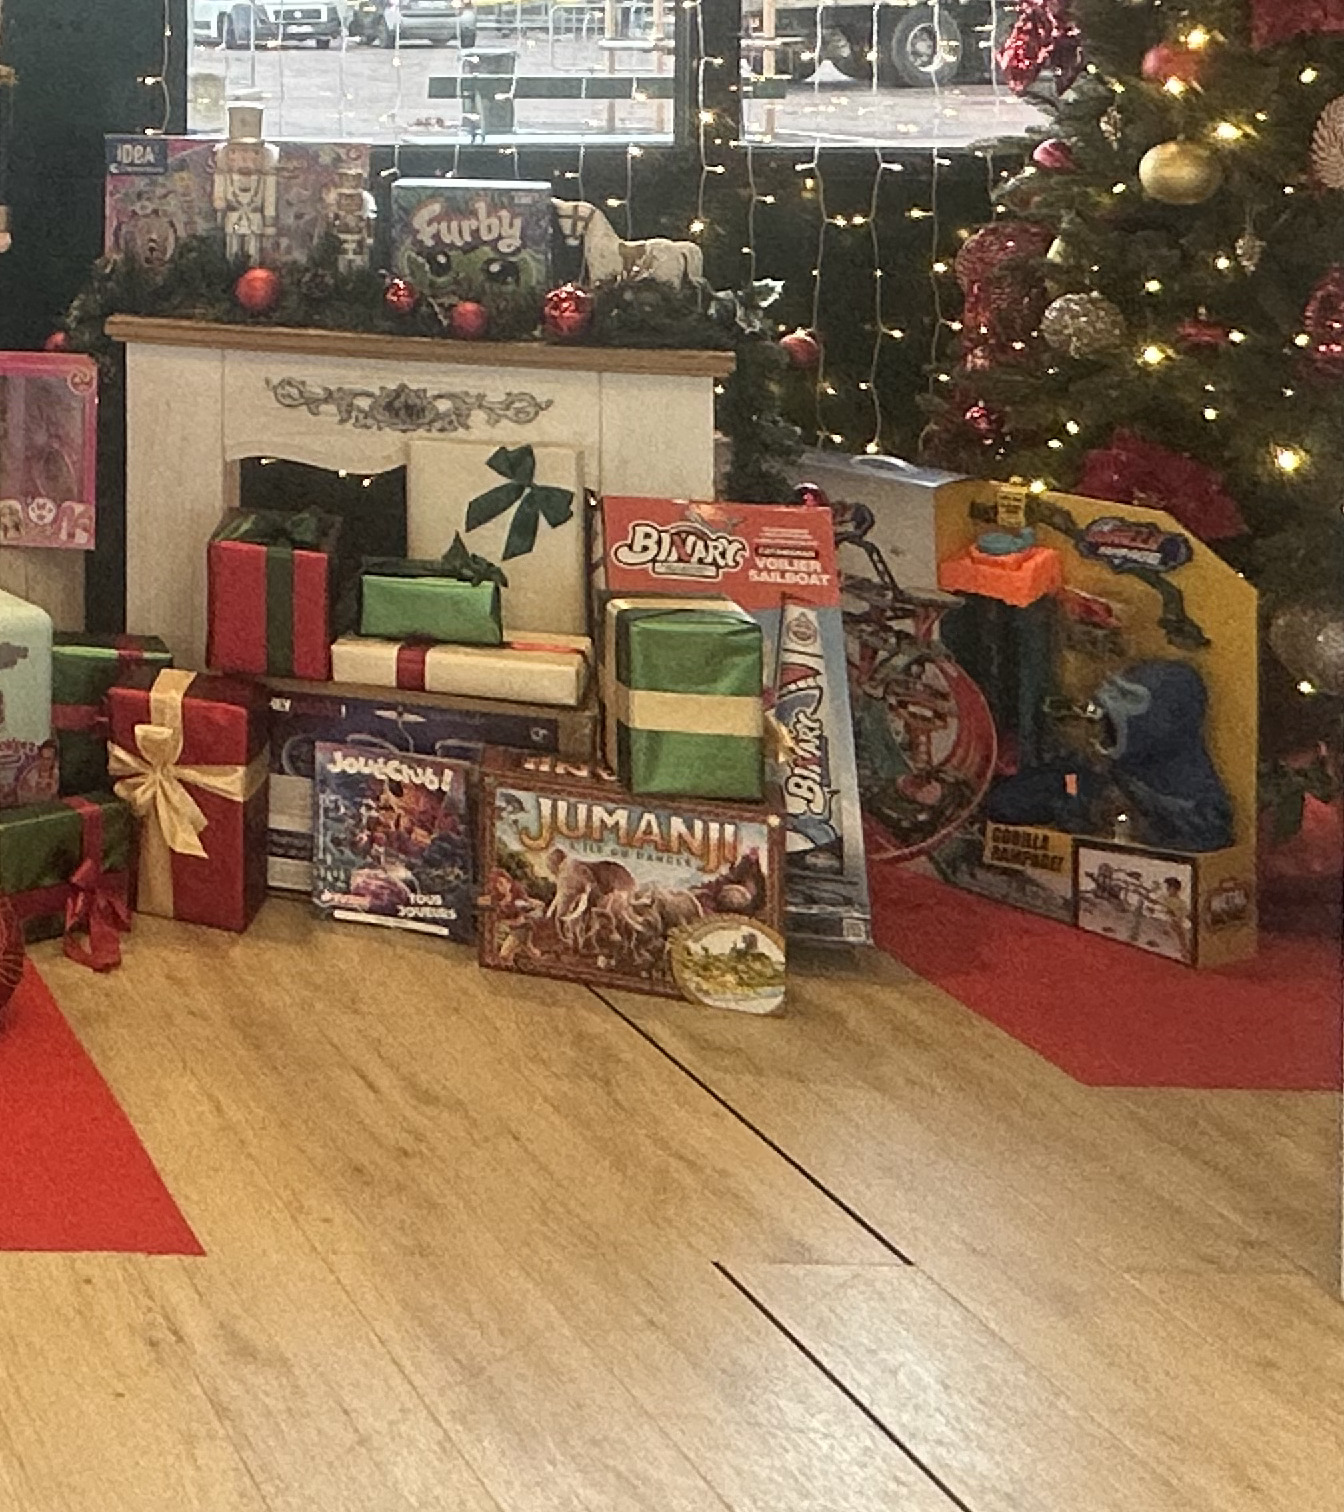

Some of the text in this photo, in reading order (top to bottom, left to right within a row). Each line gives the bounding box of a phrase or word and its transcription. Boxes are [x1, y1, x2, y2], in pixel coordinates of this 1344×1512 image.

[413, 201, 522, 253] Furby
[749, 569, 830, 585] SAILBOAT
[520, 798, 738, 874] JUMANJI
